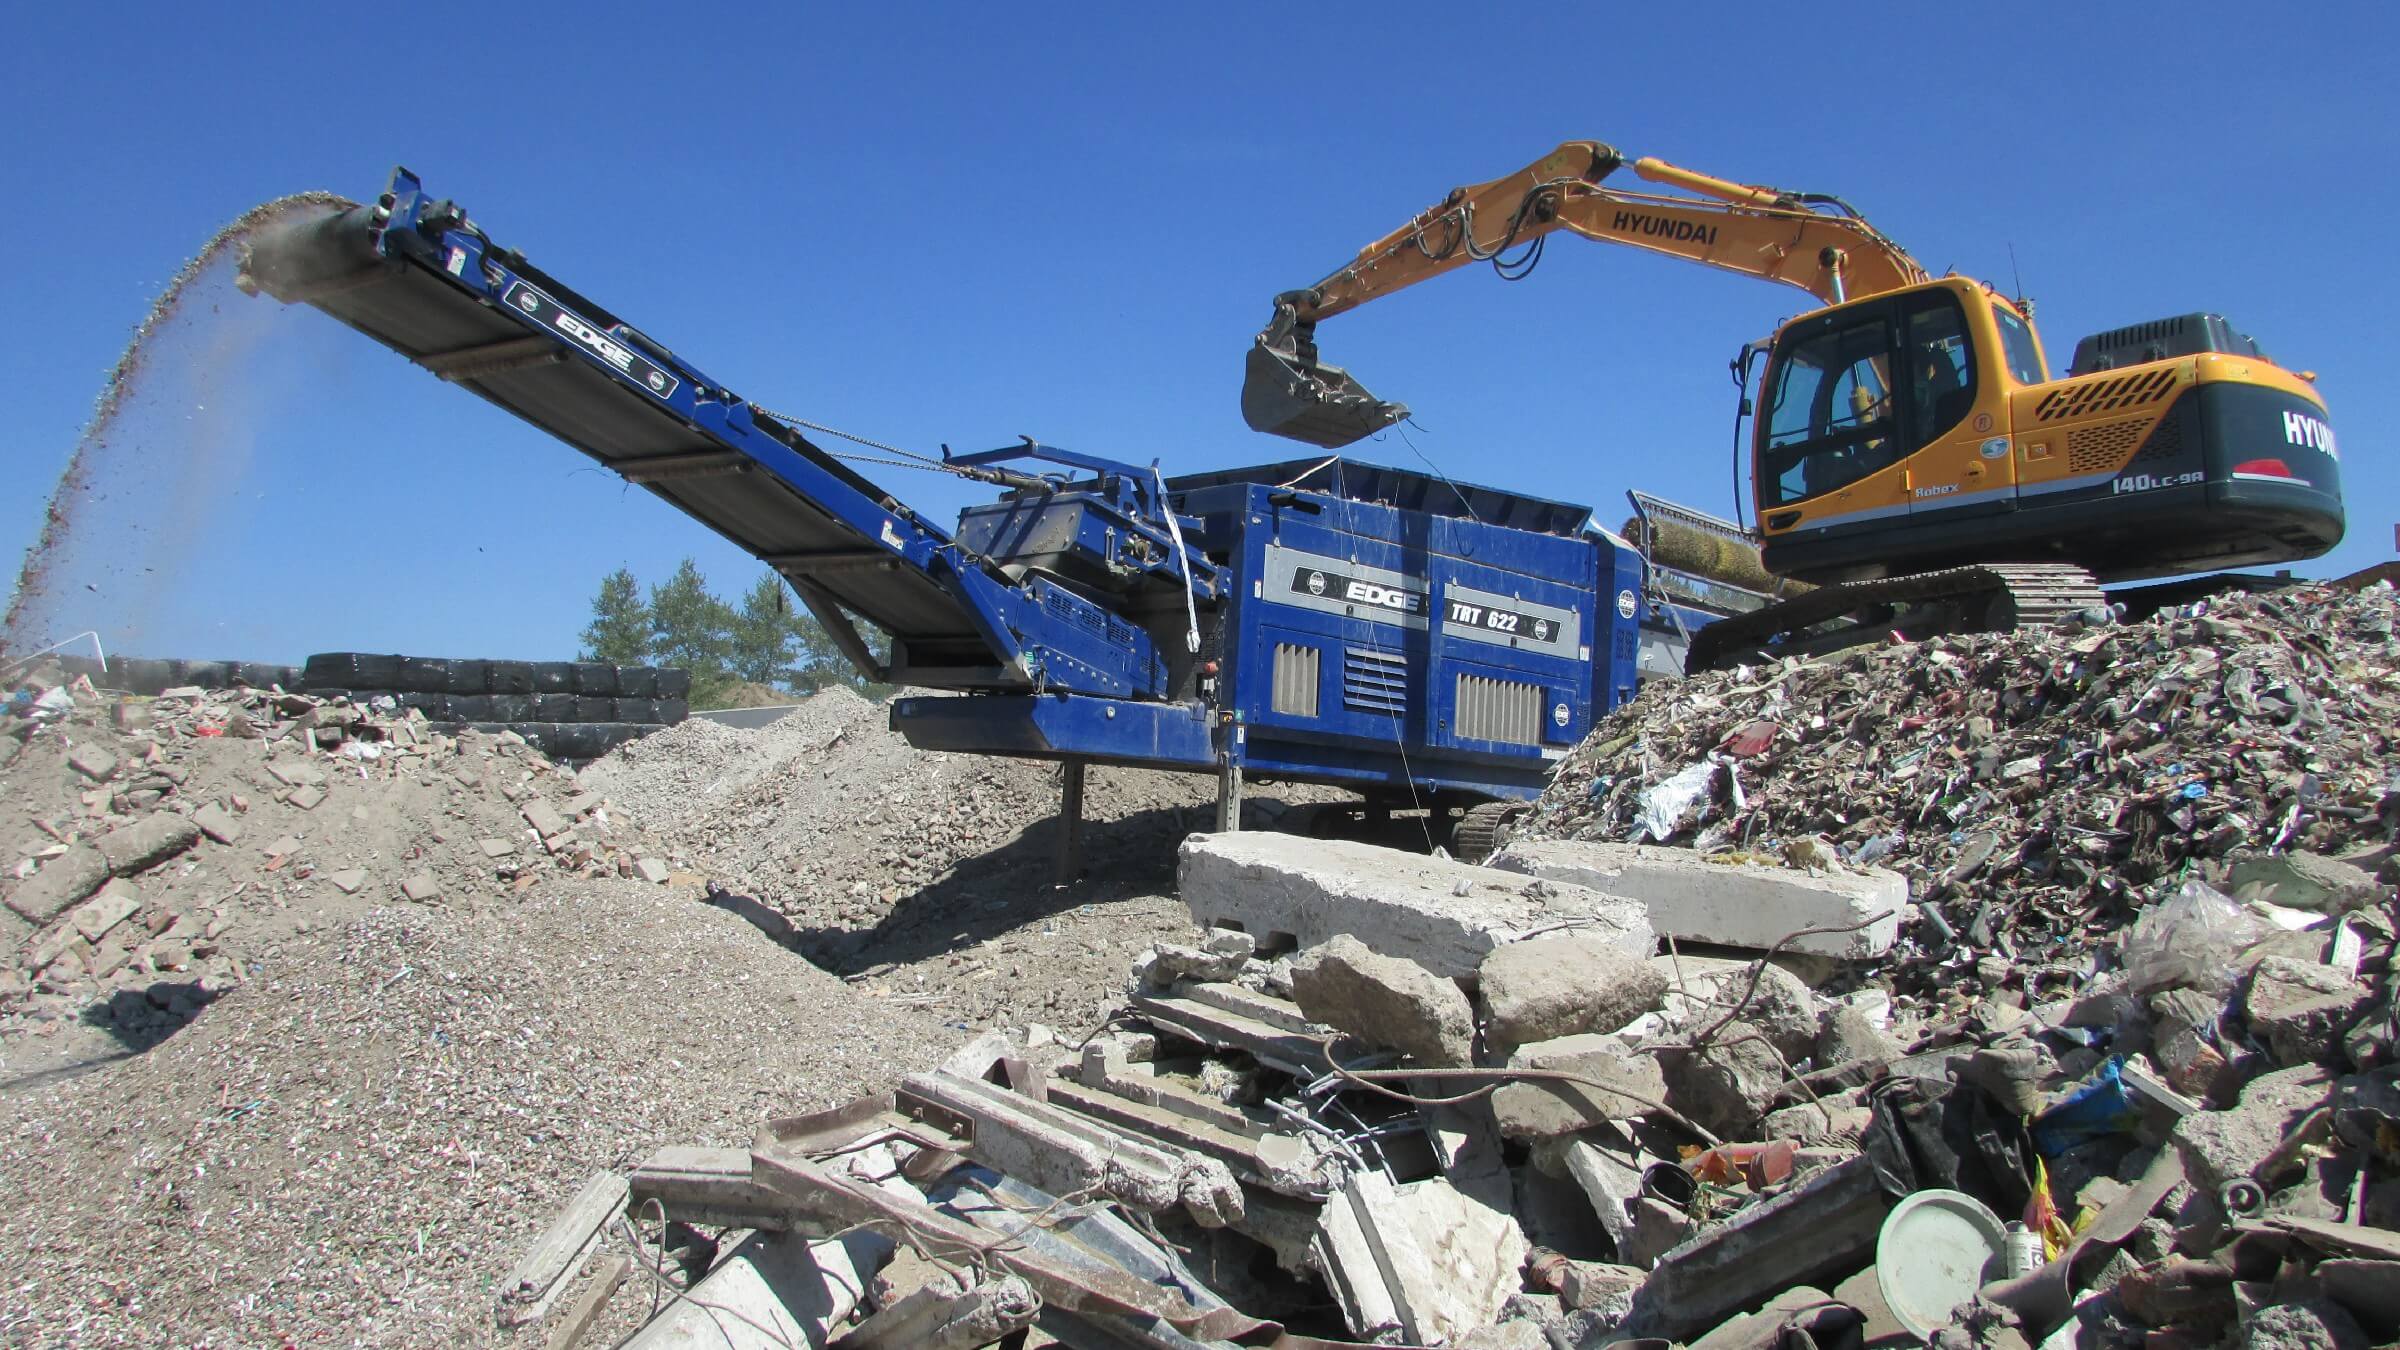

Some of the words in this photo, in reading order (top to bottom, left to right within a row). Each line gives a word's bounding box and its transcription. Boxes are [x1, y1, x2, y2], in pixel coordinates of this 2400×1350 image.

[1612, 211, 1717, 245] HYUNDAI
[555, 313, 634, 373] EDGE
[1915, 483, 1960, 497] Robex
[1346, 581, 1420, 612] EDGE
[1452, 603, 1481, 625] TRT
[1487, 611, 1518, 632] 622
